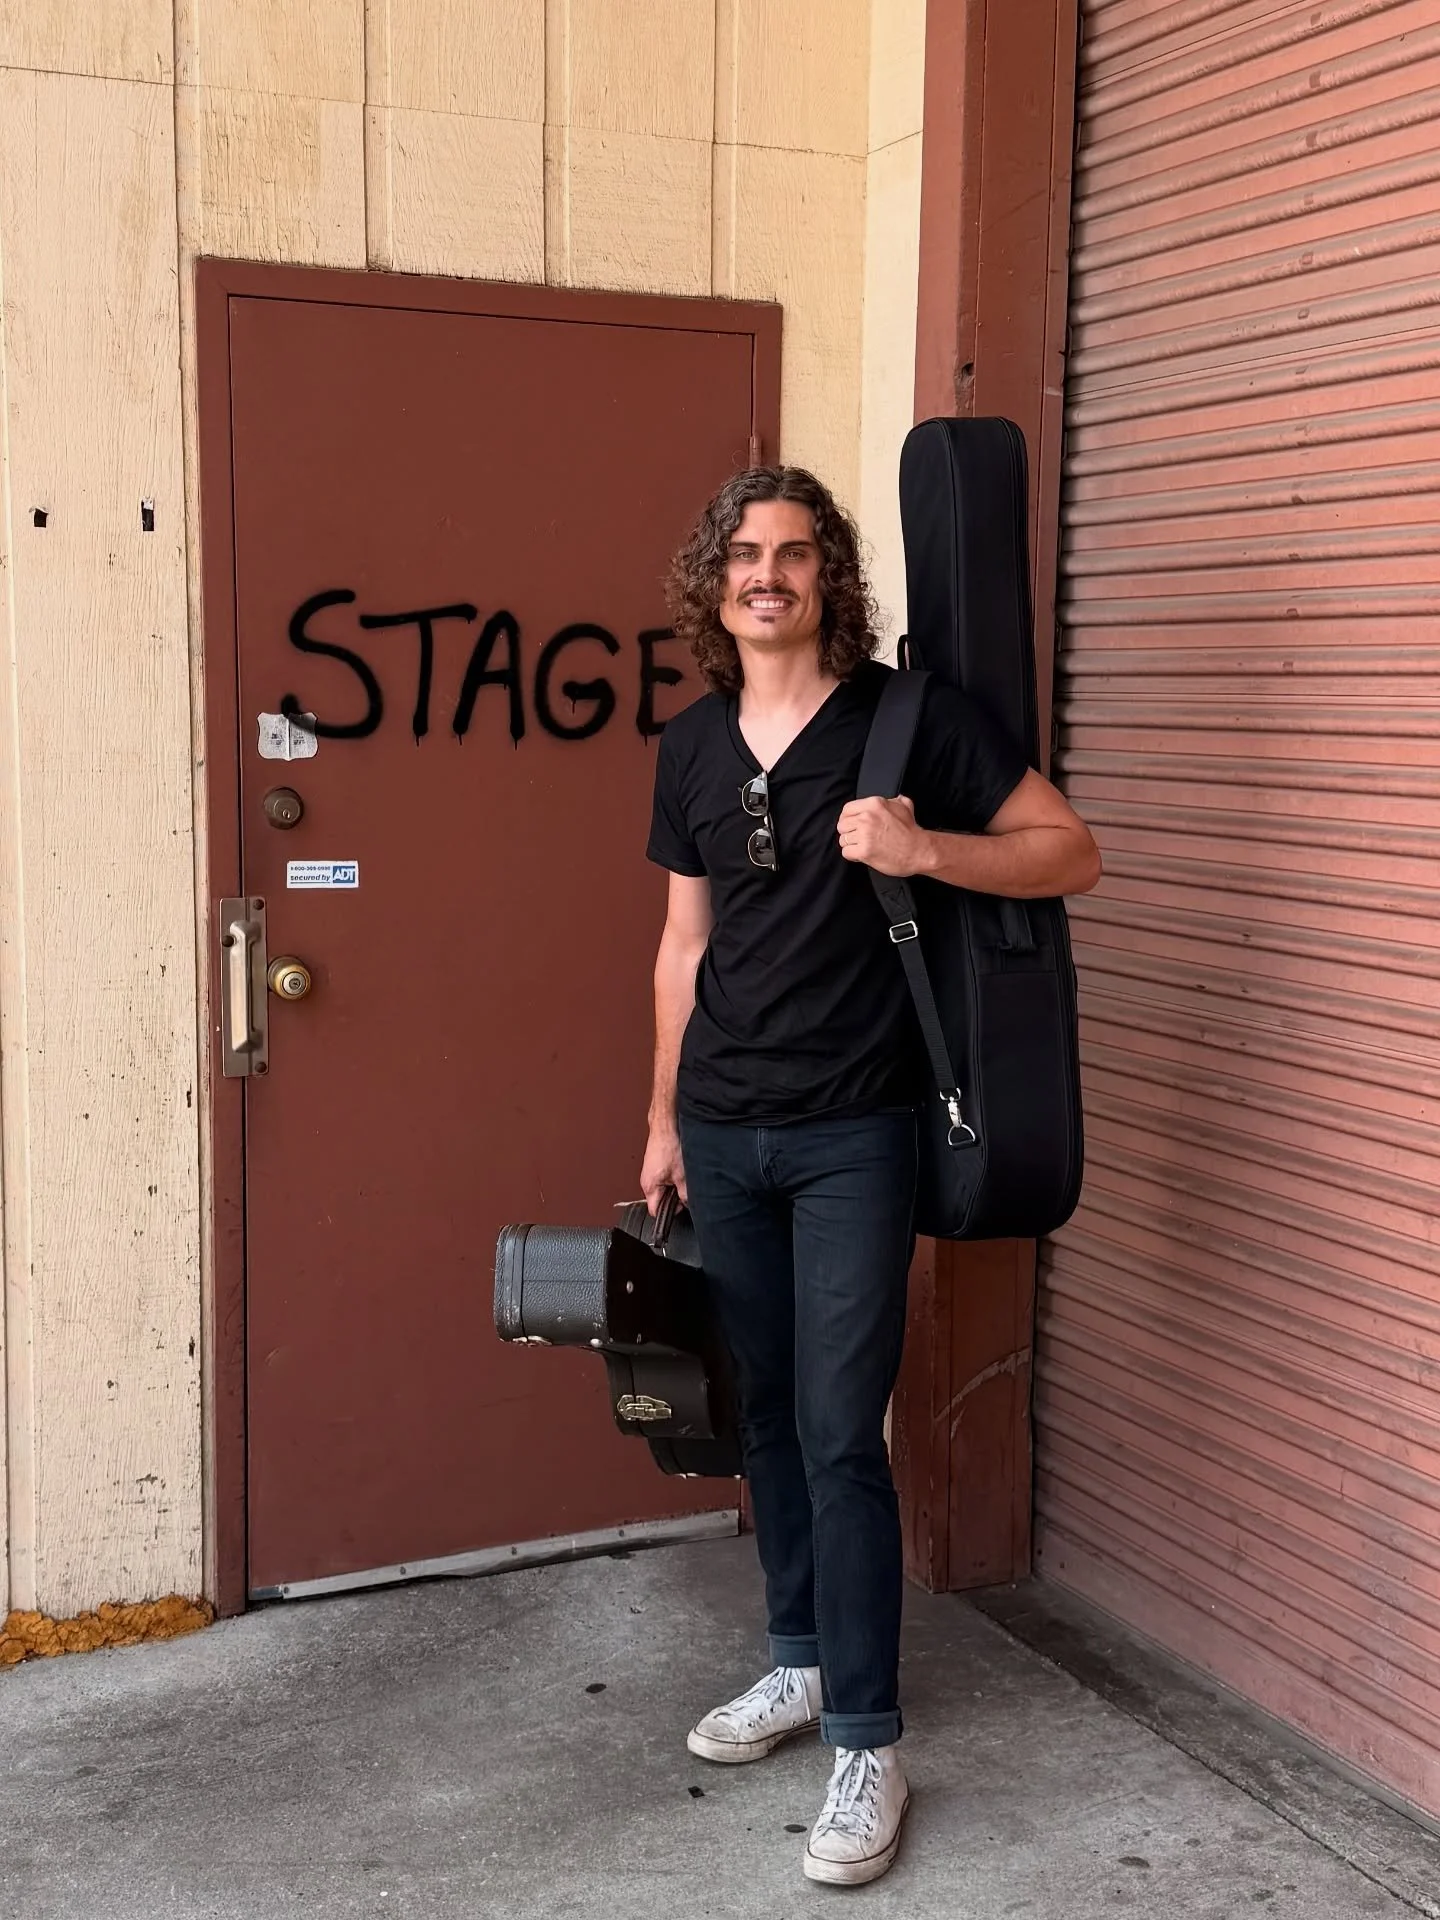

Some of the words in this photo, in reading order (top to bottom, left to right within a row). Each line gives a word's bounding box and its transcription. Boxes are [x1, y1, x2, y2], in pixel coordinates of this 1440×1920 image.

[281, 588, 684, 746] STAGE
[321, 874, 331, 882] by
[333, 868, 356, 881] ADT
